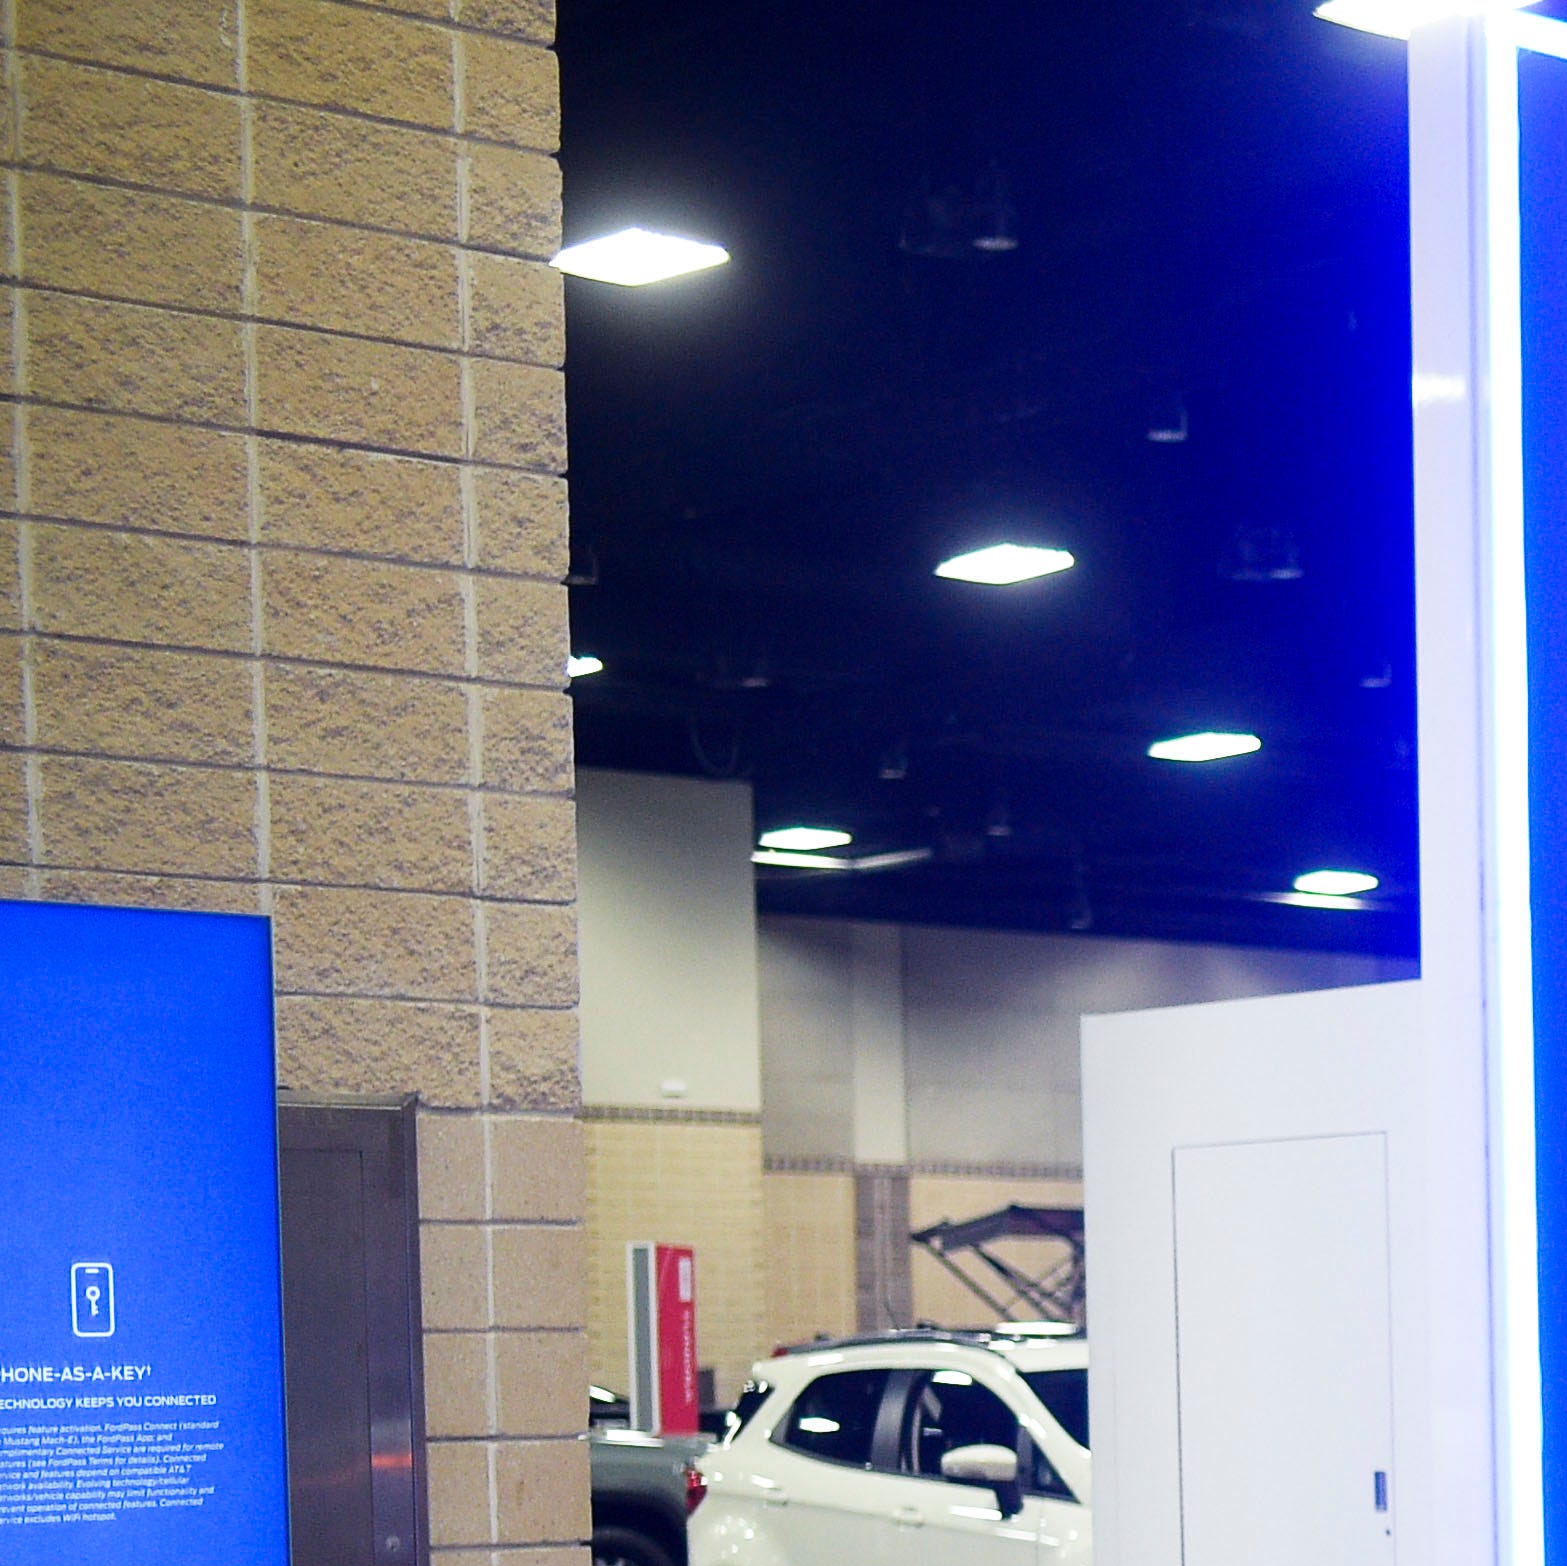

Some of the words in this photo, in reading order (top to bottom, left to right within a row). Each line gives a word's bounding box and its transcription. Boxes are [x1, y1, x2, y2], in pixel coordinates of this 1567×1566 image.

[75, 1396, 114, 1409] KEEPS
[117, 1396, 142, 1407] YOU
[144, 1394, 216, 1407] CONNECTED
[143, 1422, 177, 1431] Connect
[4, 1437, 40, 1446] Mustang
[56, 1447, 100, 1455] Connected
[163, 1453, 207, 1463] Connected
[168, 1465, 192, 1473] AT&T
[160, 1498, 203, 1508] Connected
